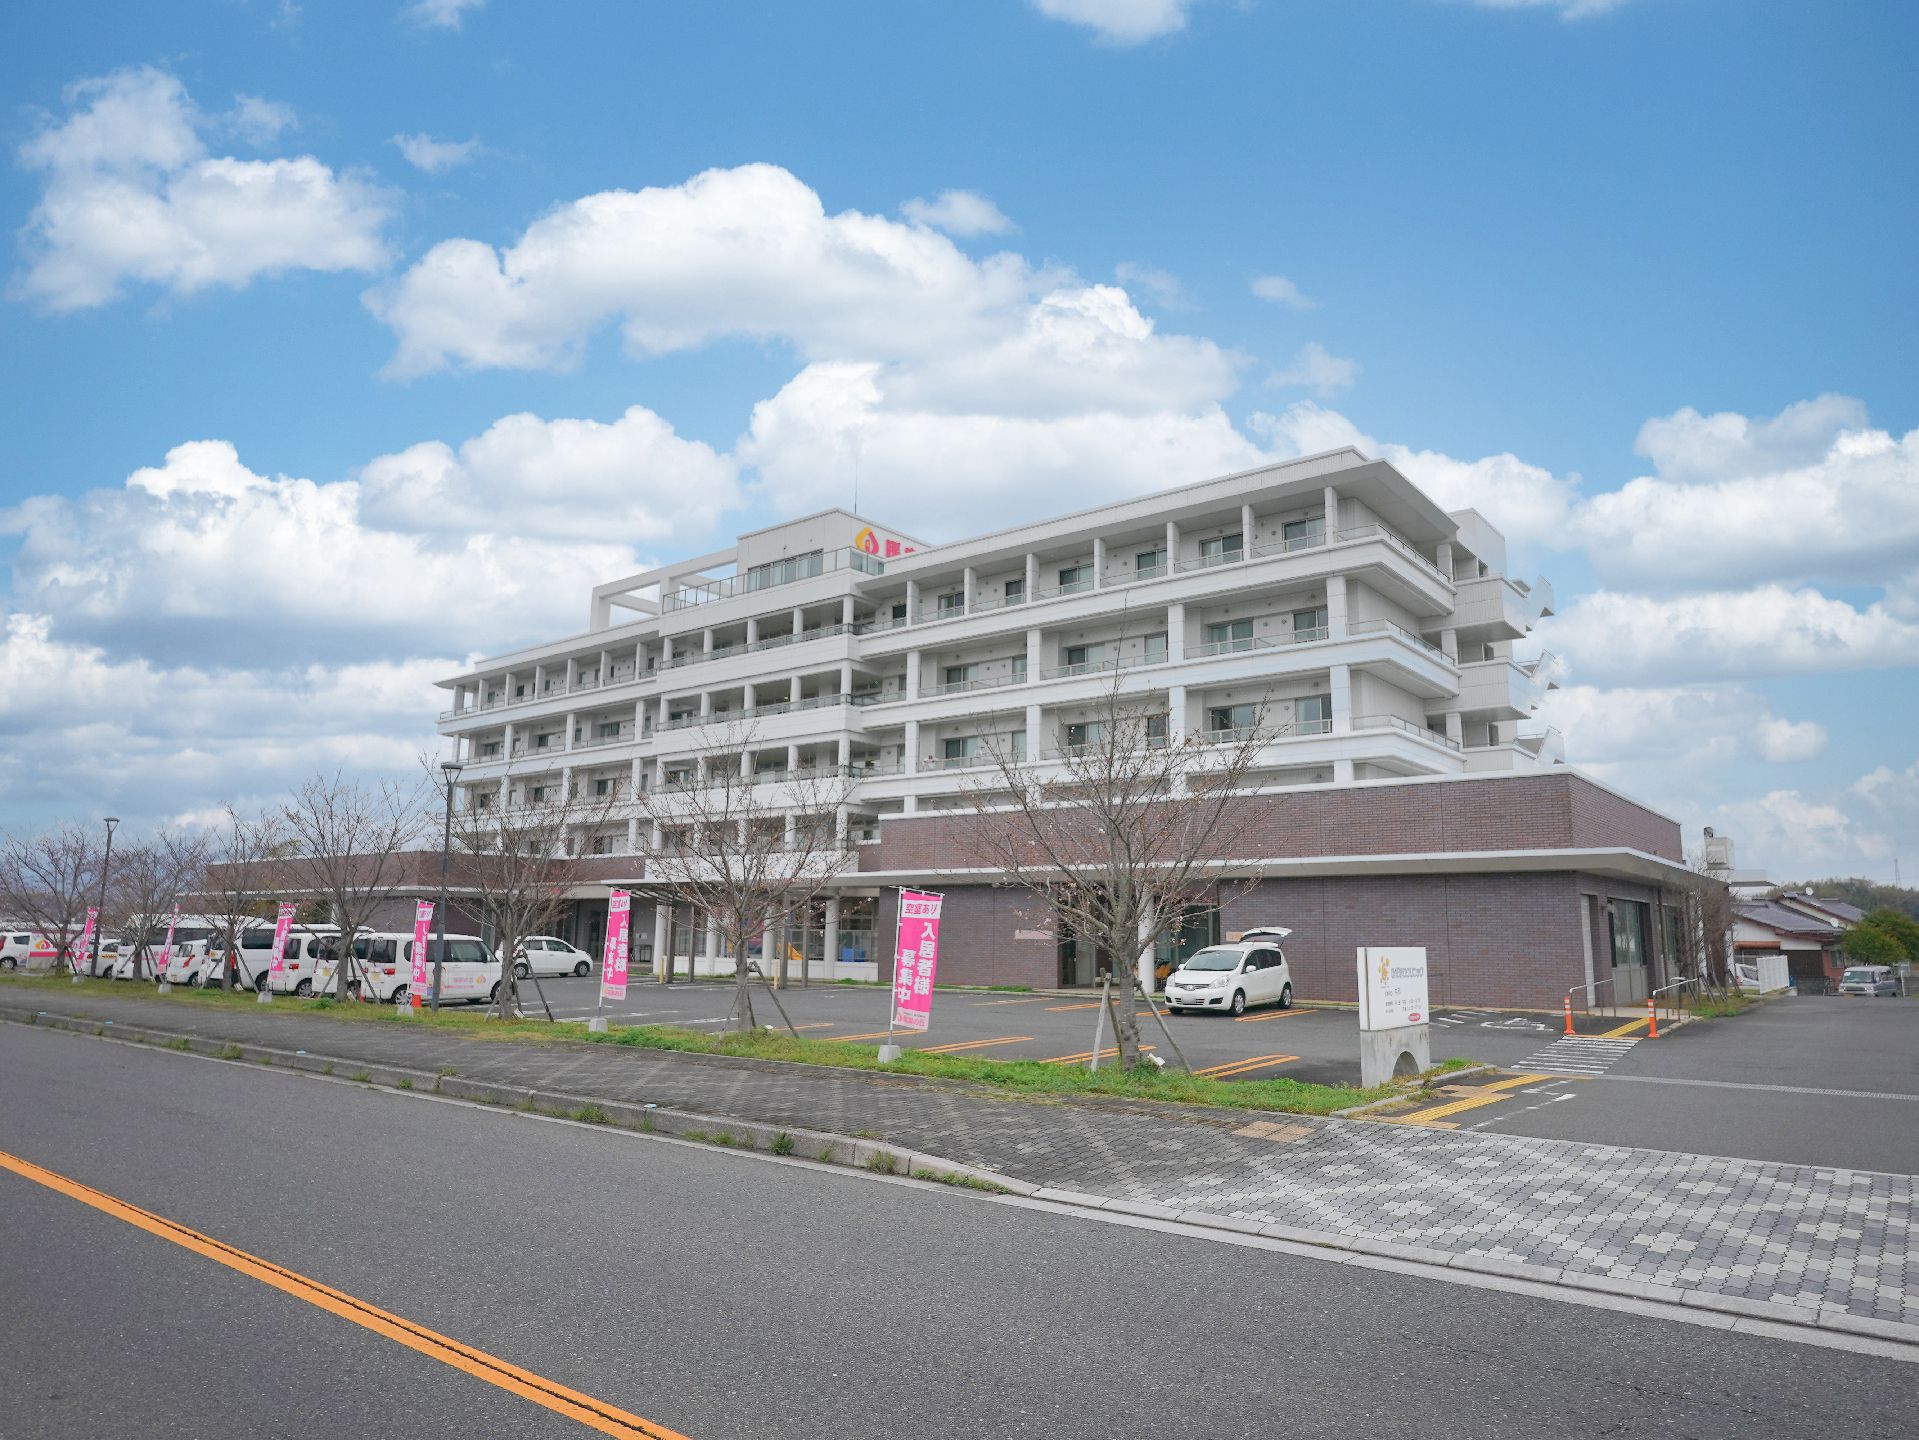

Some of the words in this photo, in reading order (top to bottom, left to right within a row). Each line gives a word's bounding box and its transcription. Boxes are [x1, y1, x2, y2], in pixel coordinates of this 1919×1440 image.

[904, 903, 938, 915] 空室あり
[898, 949, 916, 1003] 募集中
[914, 921, 936, 995] 入居者様
